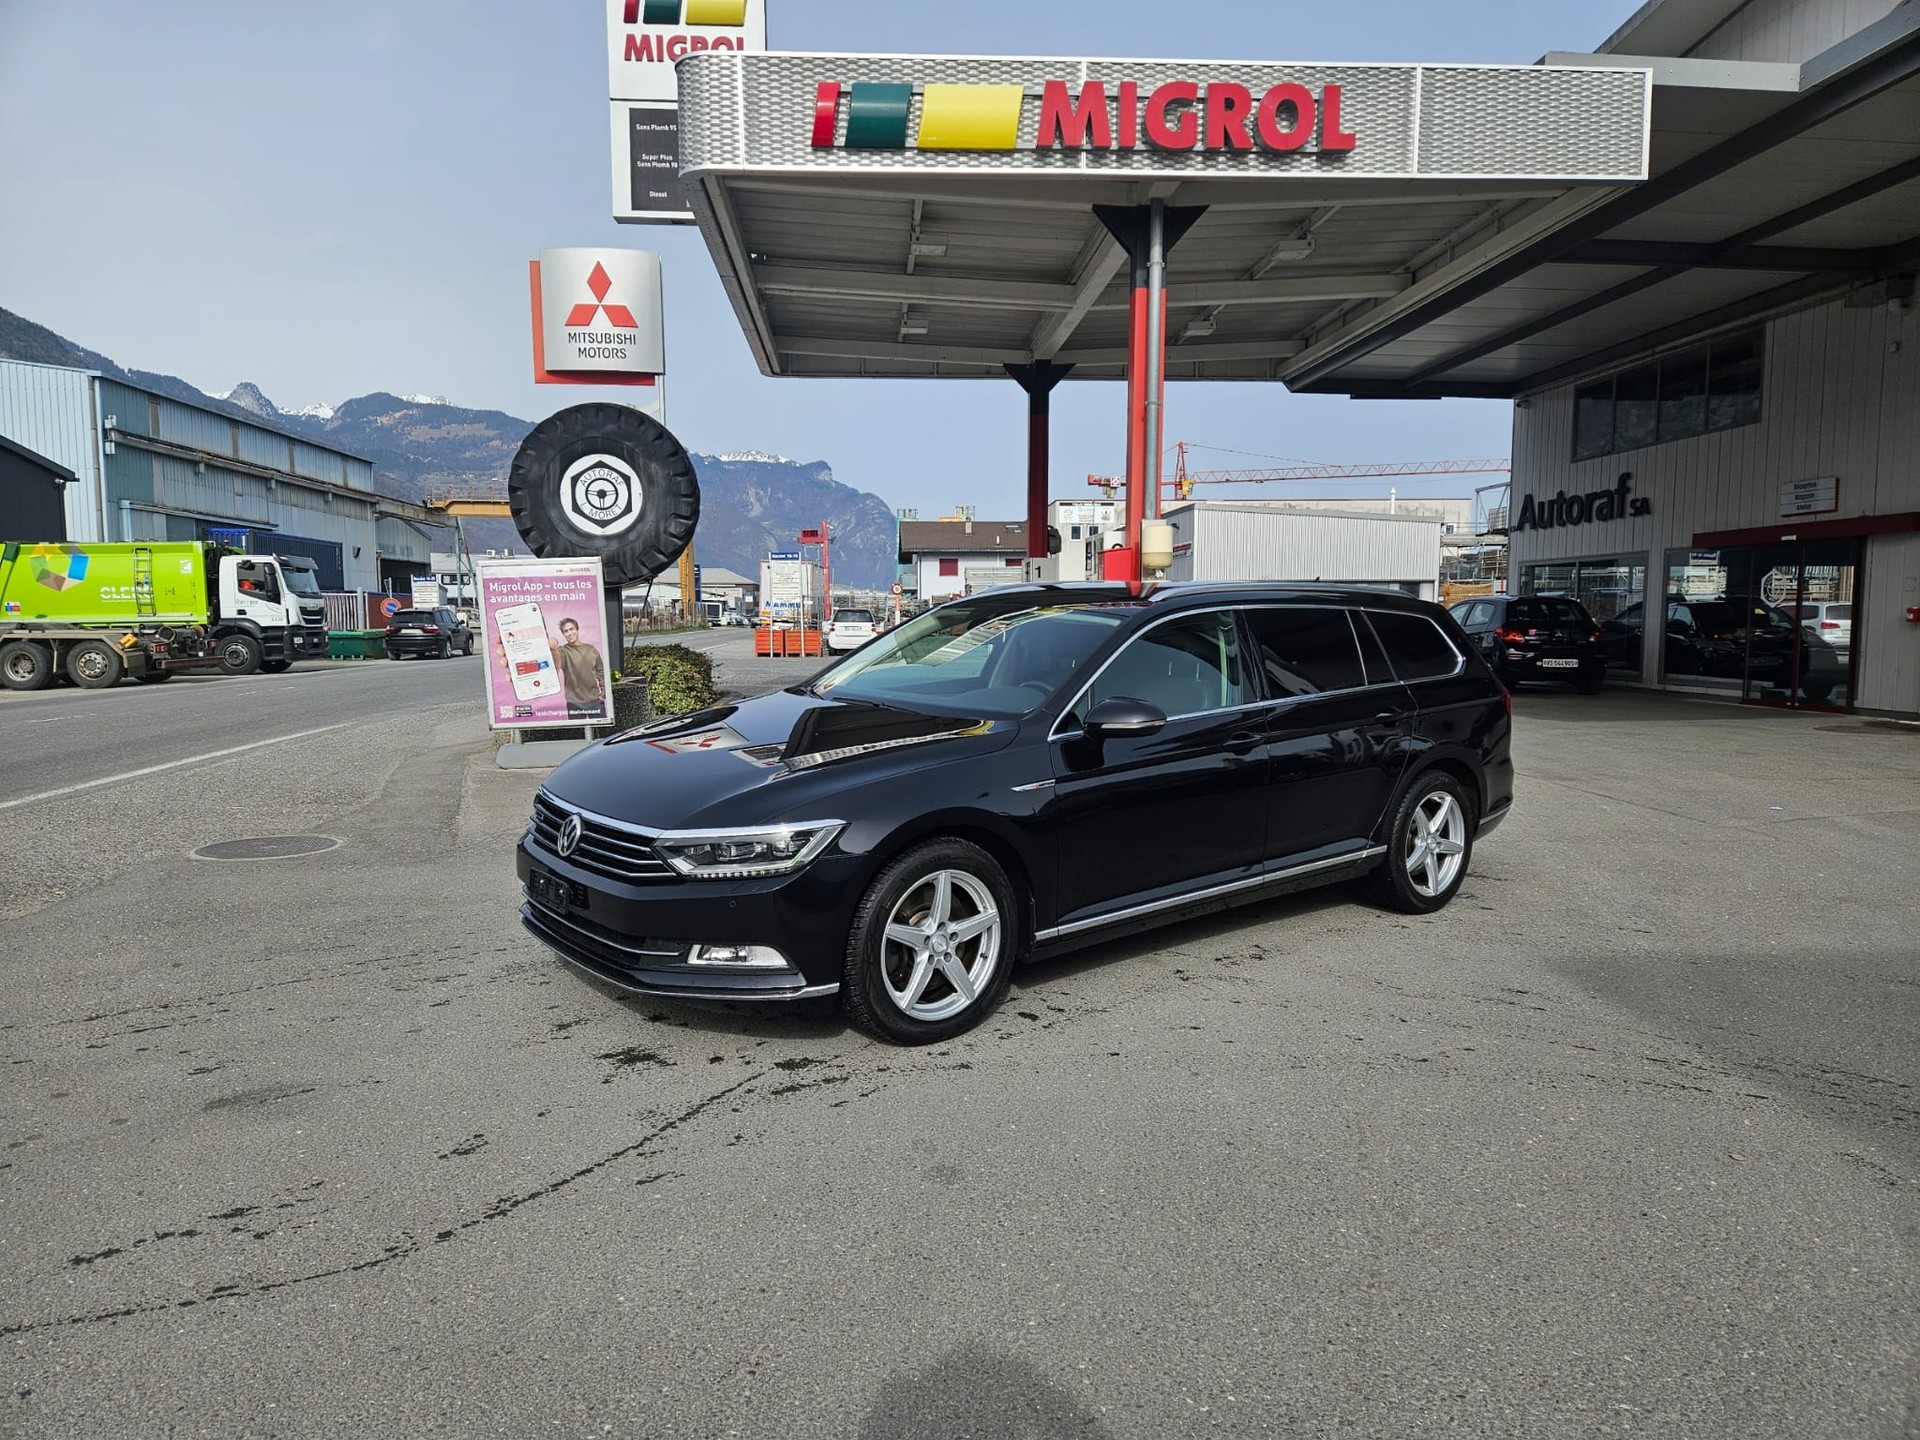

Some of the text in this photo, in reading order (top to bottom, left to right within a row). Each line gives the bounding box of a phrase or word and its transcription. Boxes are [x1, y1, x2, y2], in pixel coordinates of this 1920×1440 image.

[1036, 80, 1356, 151] MIGROL
[636, 123, 677, 132] Sans Plomb 95
[642, 154, 658, 162] Super
[670, 161, 678, 169] 98
[568, 332, 636, 345] MITSUBISHI
[578, 346, 627, 360] MOTORS
[580, 468, 625, 487] AUTORAF
[1517, 472, 1651, 530] Autoraf SA
[588, 503, 623, 519] MORET
[1035, 565, 1041, 578] 1
[489, 582, 521, 593] Migrol
[523, 581, 543, 592] App
[553, 581, 575, 590] tous
[576, 580, 592, 589] les
[490, 592, 585, 604] avantages en main
